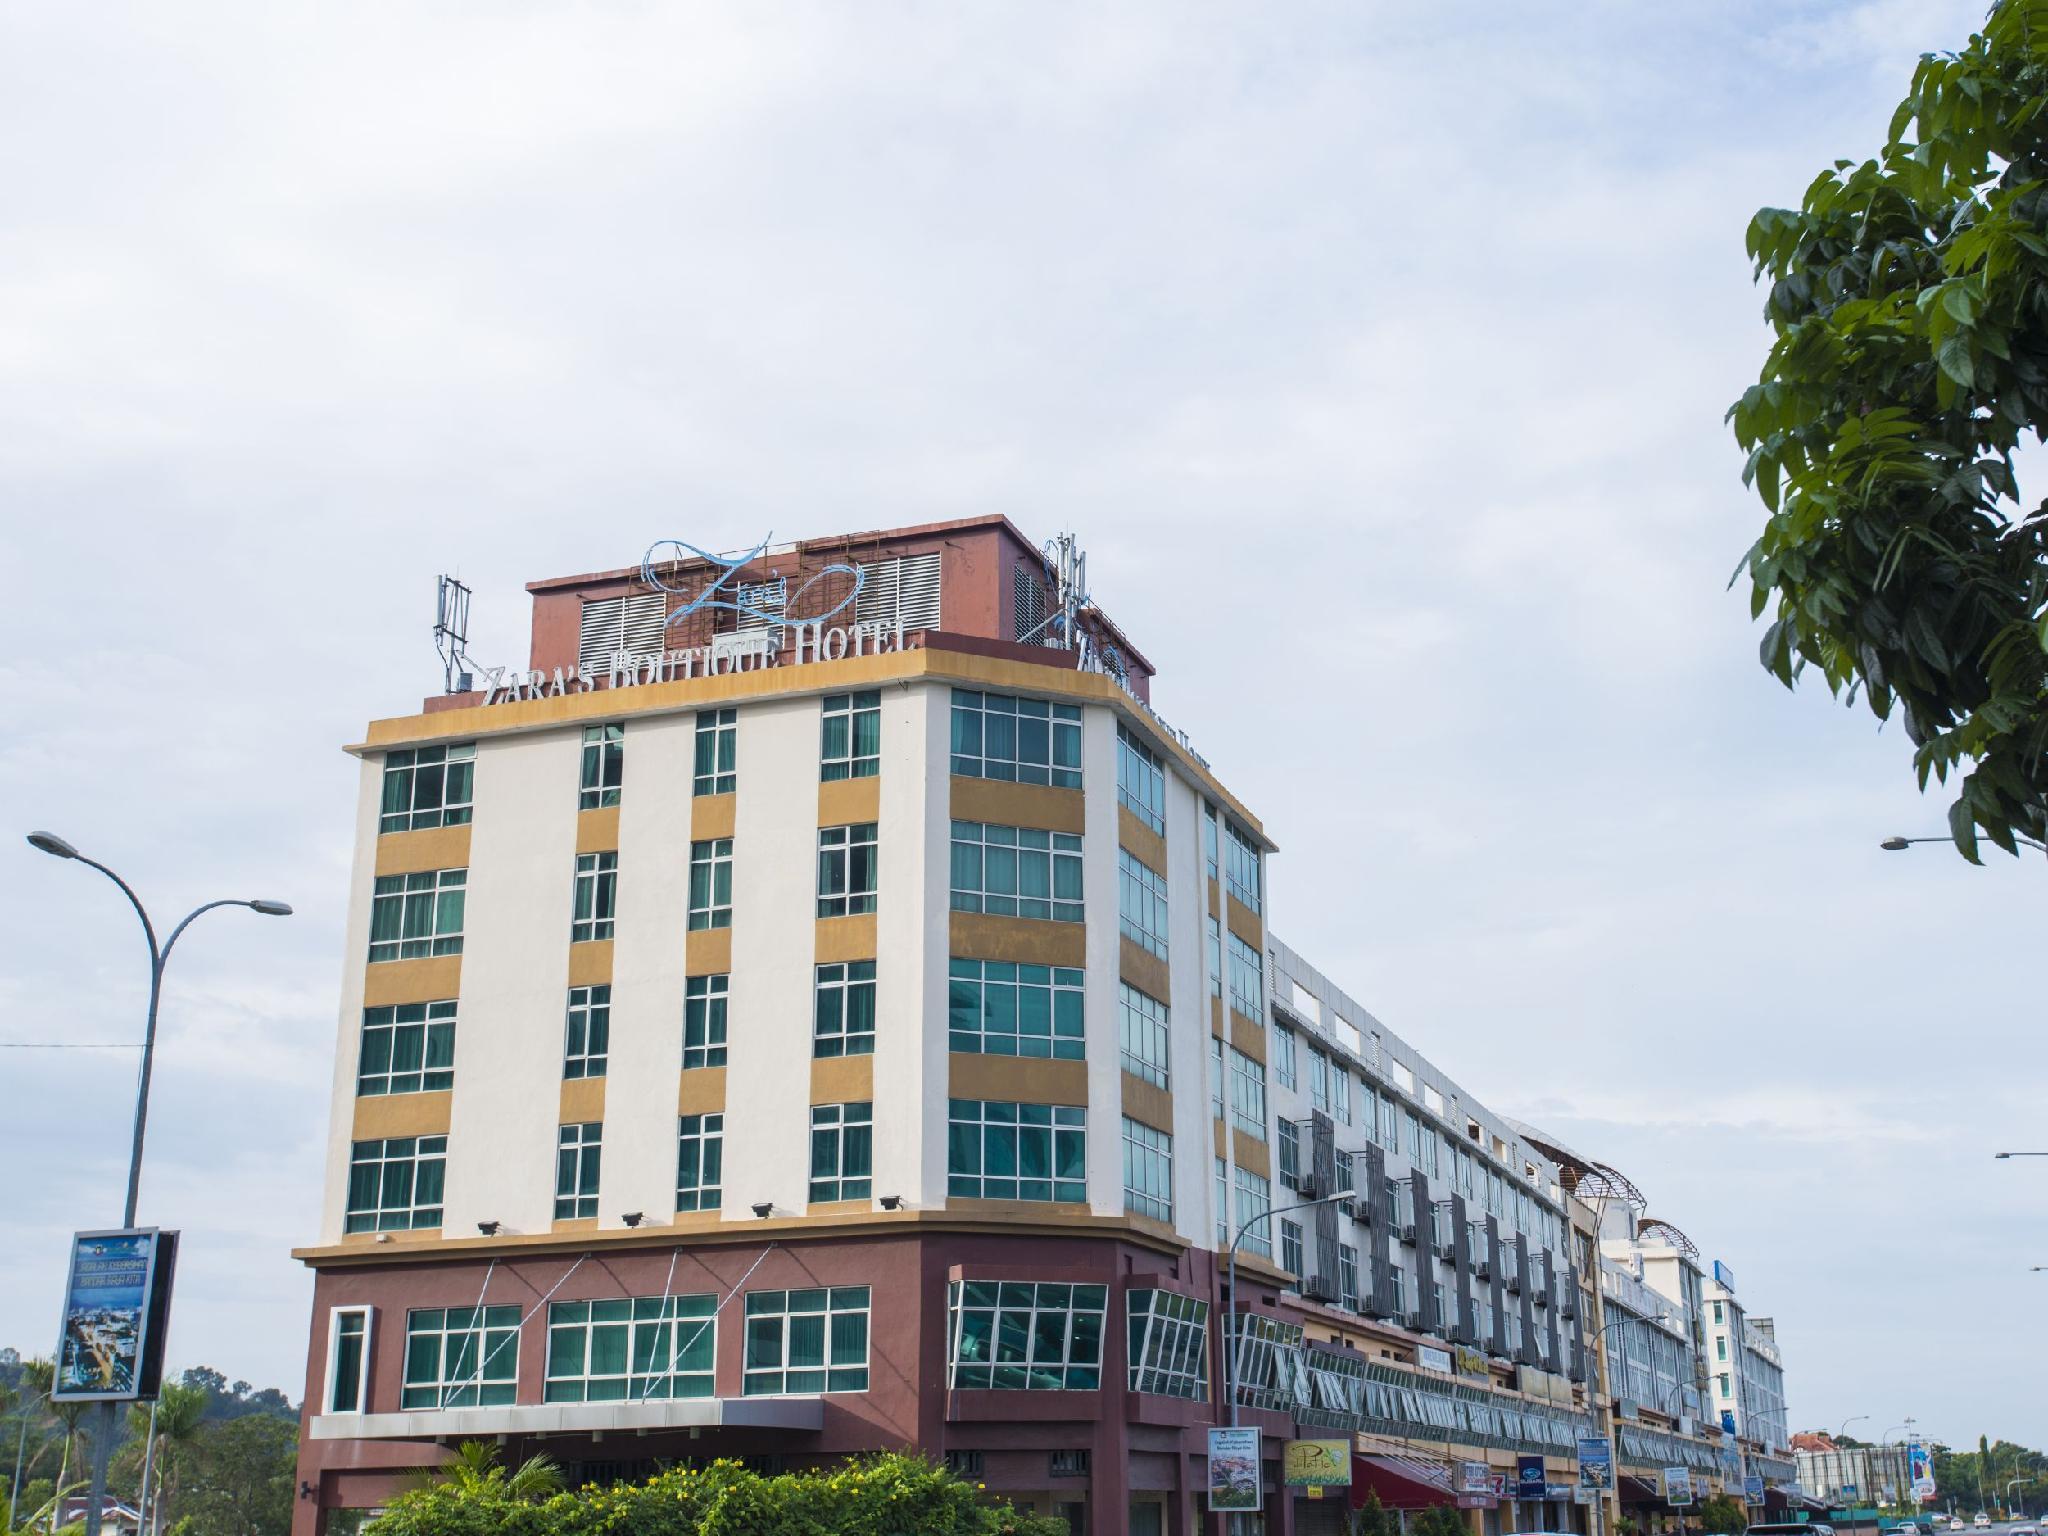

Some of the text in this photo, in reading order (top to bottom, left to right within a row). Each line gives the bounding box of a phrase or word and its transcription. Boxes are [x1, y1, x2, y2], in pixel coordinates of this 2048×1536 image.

[482, 617, 918, 706] ZARA'S BOUTIQUE HOTEL
